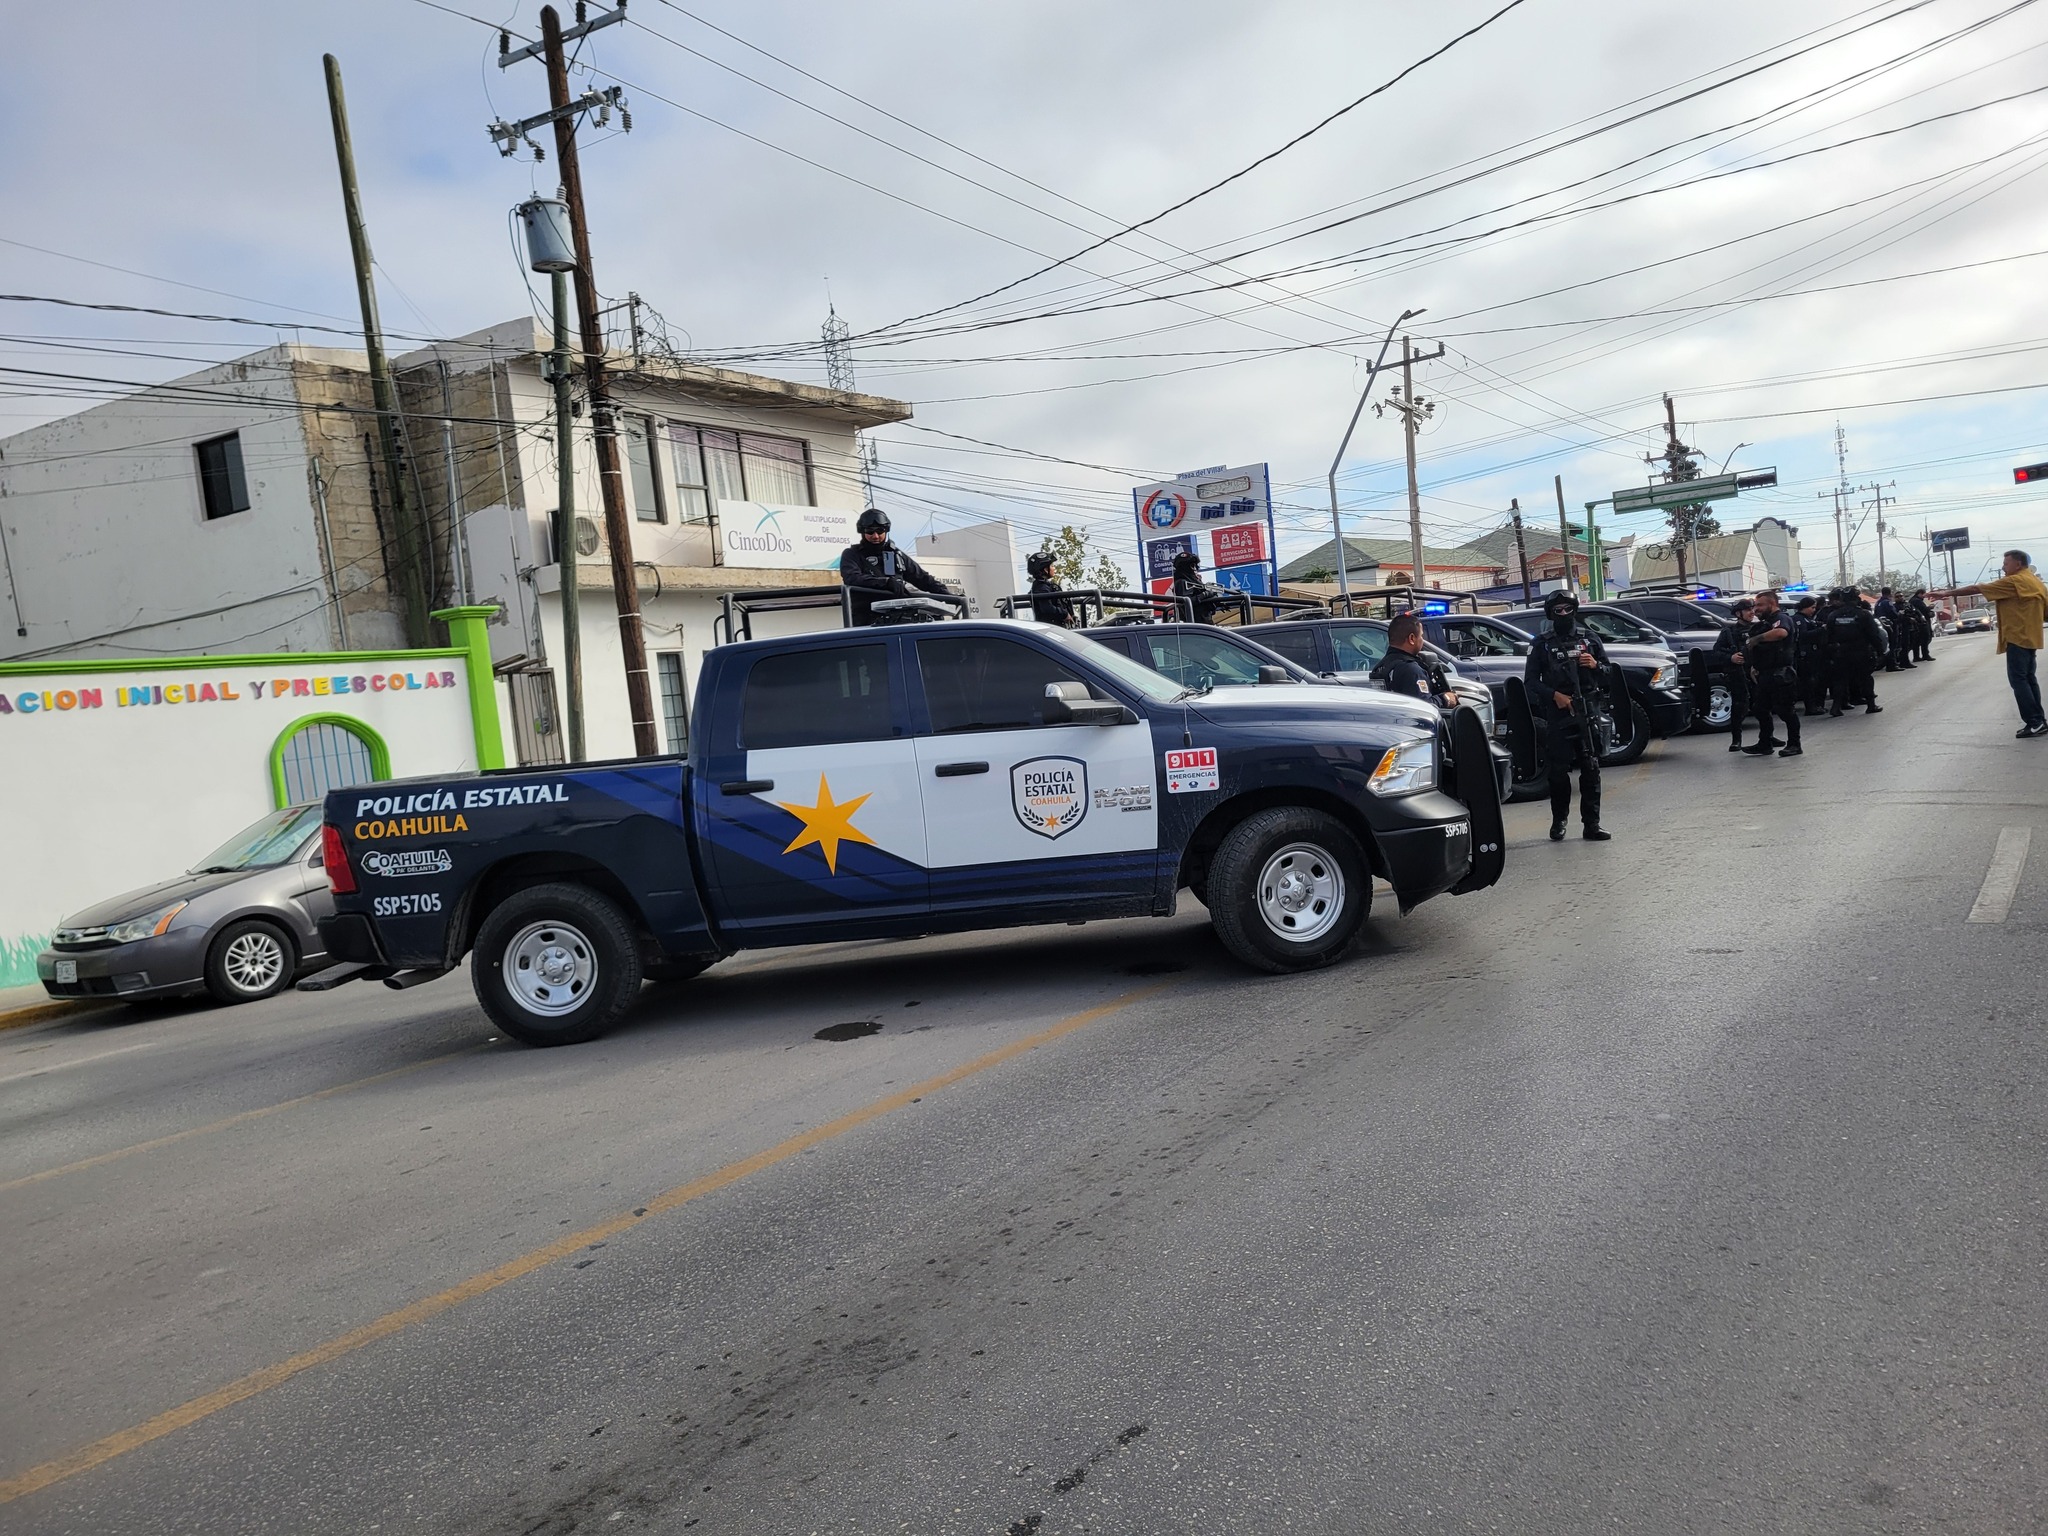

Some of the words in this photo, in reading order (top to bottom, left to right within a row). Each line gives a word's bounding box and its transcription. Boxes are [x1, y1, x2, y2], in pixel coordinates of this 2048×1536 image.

[1178, 472, 1195, 480] Plaza
[1196, 469, 1206, 477] del
[803, 515, 847, 524] MULTIPLICADOR
[728, 530, 792, 552] CincoDos
[804, 535, 850, 544] OPORTUNIDADES
[1943, 535, 1968, 543] Steren
[1220, 548, 1247, 557] SERVICIOS
[116, 682, 239, 707] INICIAL
[251, 681, 266, 699] Y
[272, 671, 456, 697] PREESCOLAR
[1170, 752, 1211, 768] 911
[1024, 768, 1074, 785] POLICÍA
[1169, 771, 1216, 780] EMERGENCIAS
[1025, 783, 1076, 797] ESTATAL
[1094, 784, 1150, 798] RAM
[356, 789, 457, 817] POLICÍA
[463, 784, 569, 809] ESTATAL
[1031, 796, 1072, 806] COAHUILA
[1096, 796, 1151, 809] 1500
[354, 814, 469, 839] COAHUILA
[1445, 822, 1469, 837] SSP5705
[361, 850, 452, 874] COAHUILA
[407, 865, 436, 873] DELANTE
[374, 893, 442, 916] SSP5705
